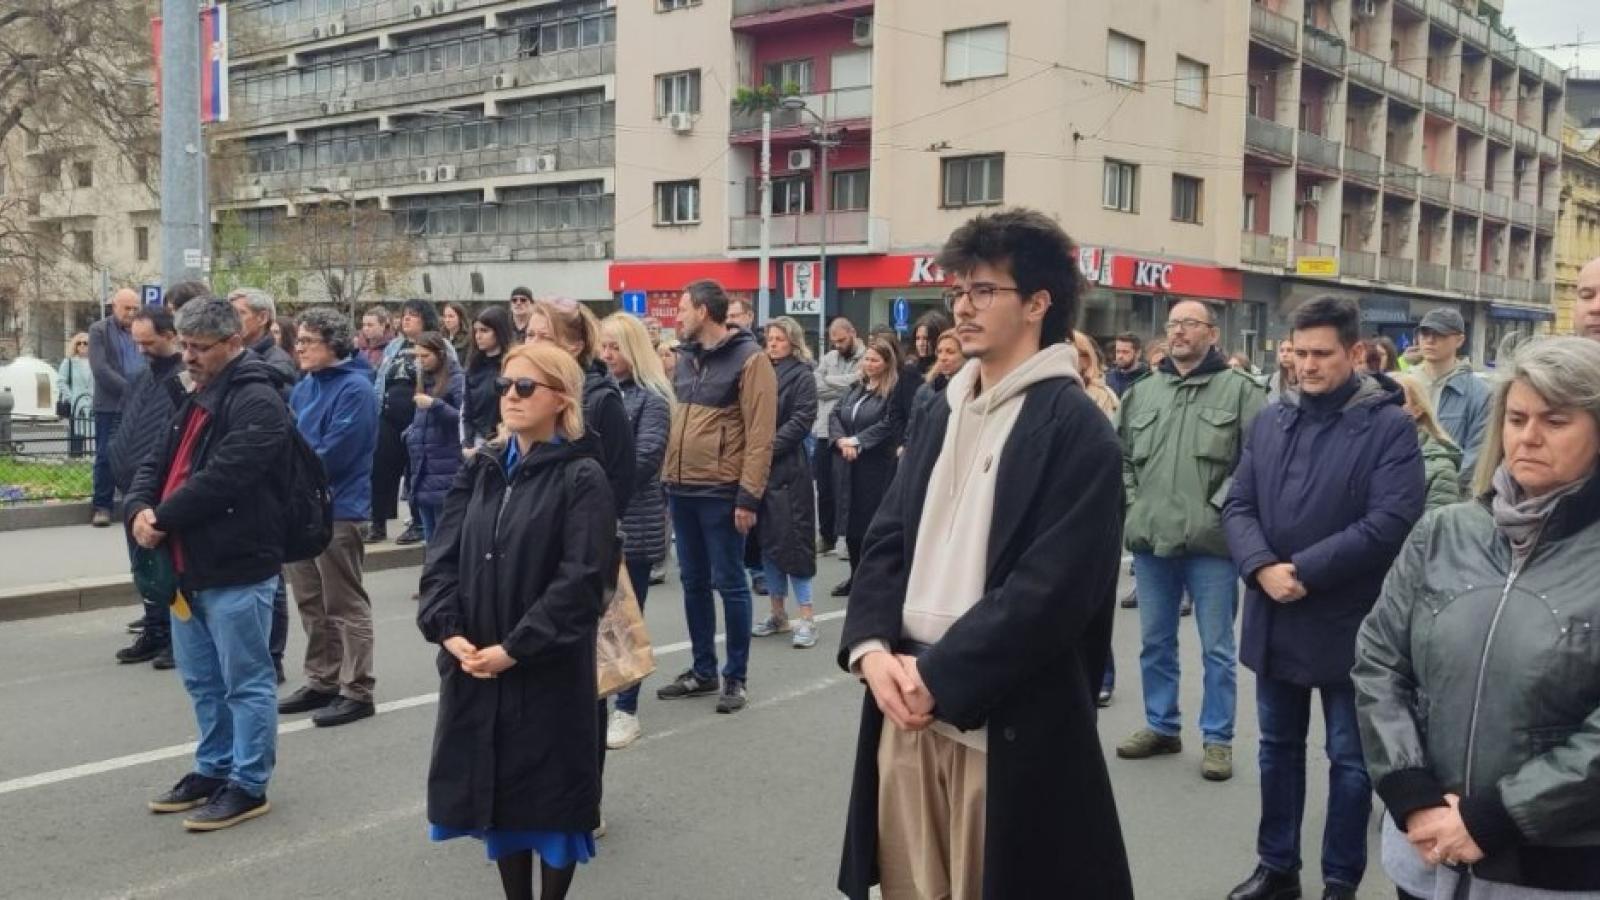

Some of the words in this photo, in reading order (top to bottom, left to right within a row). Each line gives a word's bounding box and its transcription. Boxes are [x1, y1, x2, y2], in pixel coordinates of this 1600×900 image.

[1136, 260, 1173, 289] KFC
[145, 287, 159, 305] P
[791, 300, 816, 312] KFC
